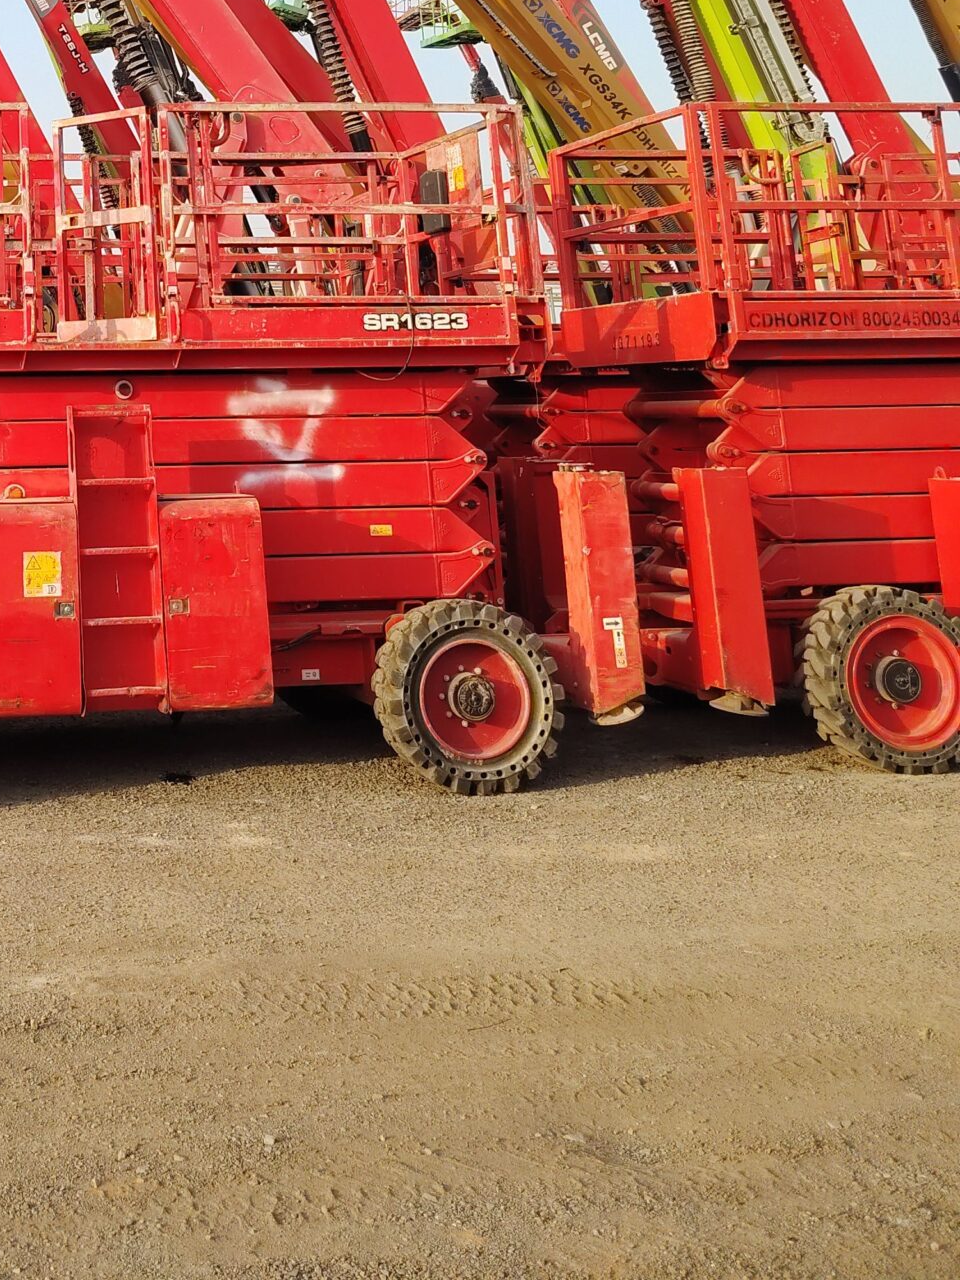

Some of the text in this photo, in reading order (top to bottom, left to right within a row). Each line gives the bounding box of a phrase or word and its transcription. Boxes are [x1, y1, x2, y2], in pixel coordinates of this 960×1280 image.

[536, 9, 581, 59] XCMG
[578, 63, 633, 121] XGS34K
[557, 93, 594, 134] XCMG
[363, 313, 468, 331] SR1623
[748, 310, 960, 328] CDHORIZON 8002450034
